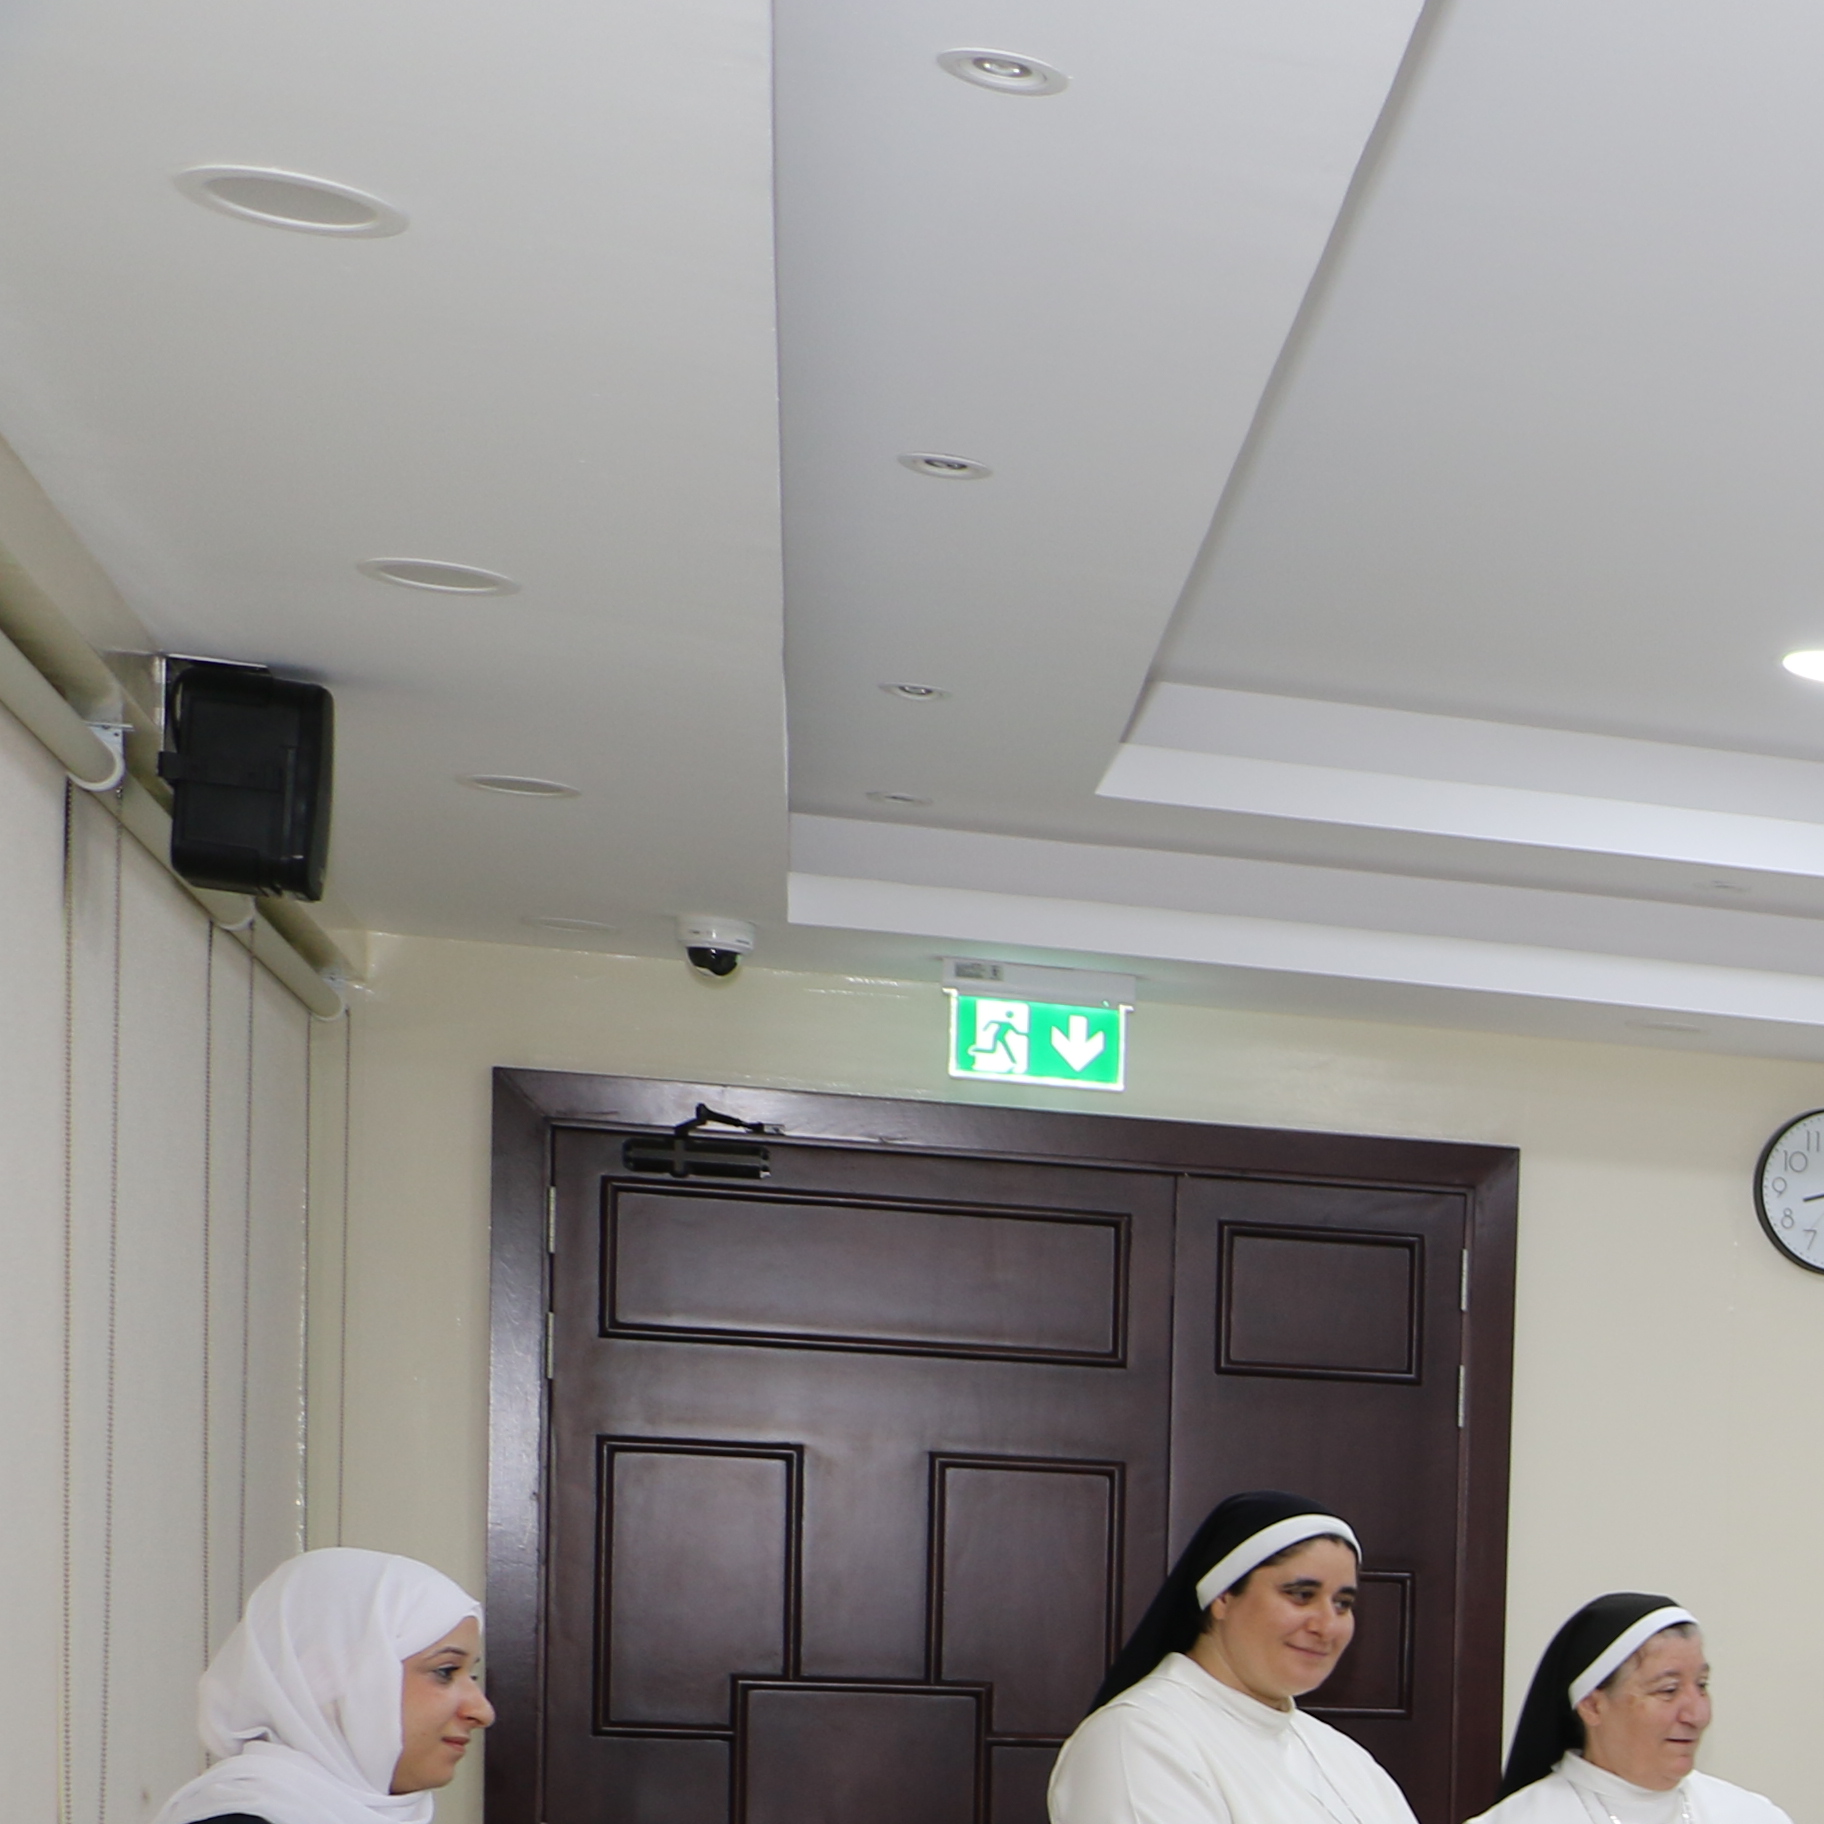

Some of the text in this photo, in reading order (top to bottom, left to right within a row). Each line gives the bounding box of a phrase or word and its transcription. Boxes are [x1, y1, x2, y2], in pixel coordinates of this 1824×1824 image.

[1806, 1129, 1821, 1153] 11
[1783, 1150, 1808, 1173] 10
[1772, 1176, 1788, 1199] 9
[1780, 1207, 1795, 1229] 8
[1803, 1228, 1818, 1251] 7
